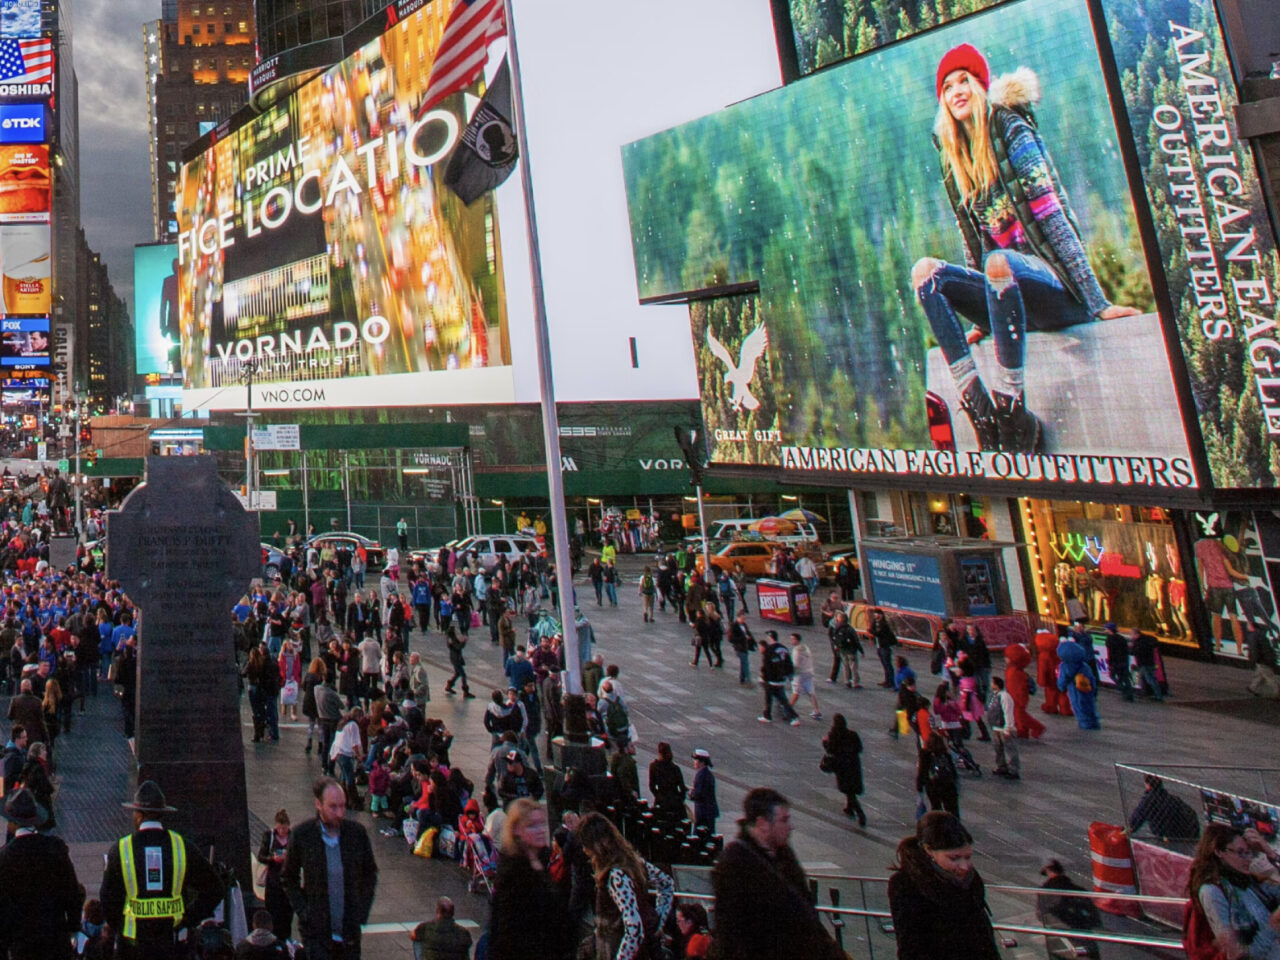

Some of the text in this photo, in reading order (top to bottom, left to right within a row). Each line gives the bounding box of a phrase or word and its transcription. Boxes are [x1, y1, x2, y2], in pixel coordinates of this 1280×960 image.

[12, 118, 40, 128] TDK
[246, 136, 311, 190] PRIME
[1153, 104, 1234, 341] OUTFITTERS
[1168, 20, 1280, 435] AMERICAN EAGLE
[177, 210, 236, 266] FICE
[3, 321, 21, 330] FOX
[55, 327, 67, 358] CALL
[216, 316, 390, 367] VORNADO
[297, 354, 356, 369] TRUST
[261, 388, 326, 402] VNO.COM
[714, 428, 748, 442] GREAT
[414, 453, 452, 465] VORNADO
[783, 446, 1196, 487] AMERICAN EAGLE OUTFITTERS
[130, 899, 182, 916] PUBLIC SAFETY
